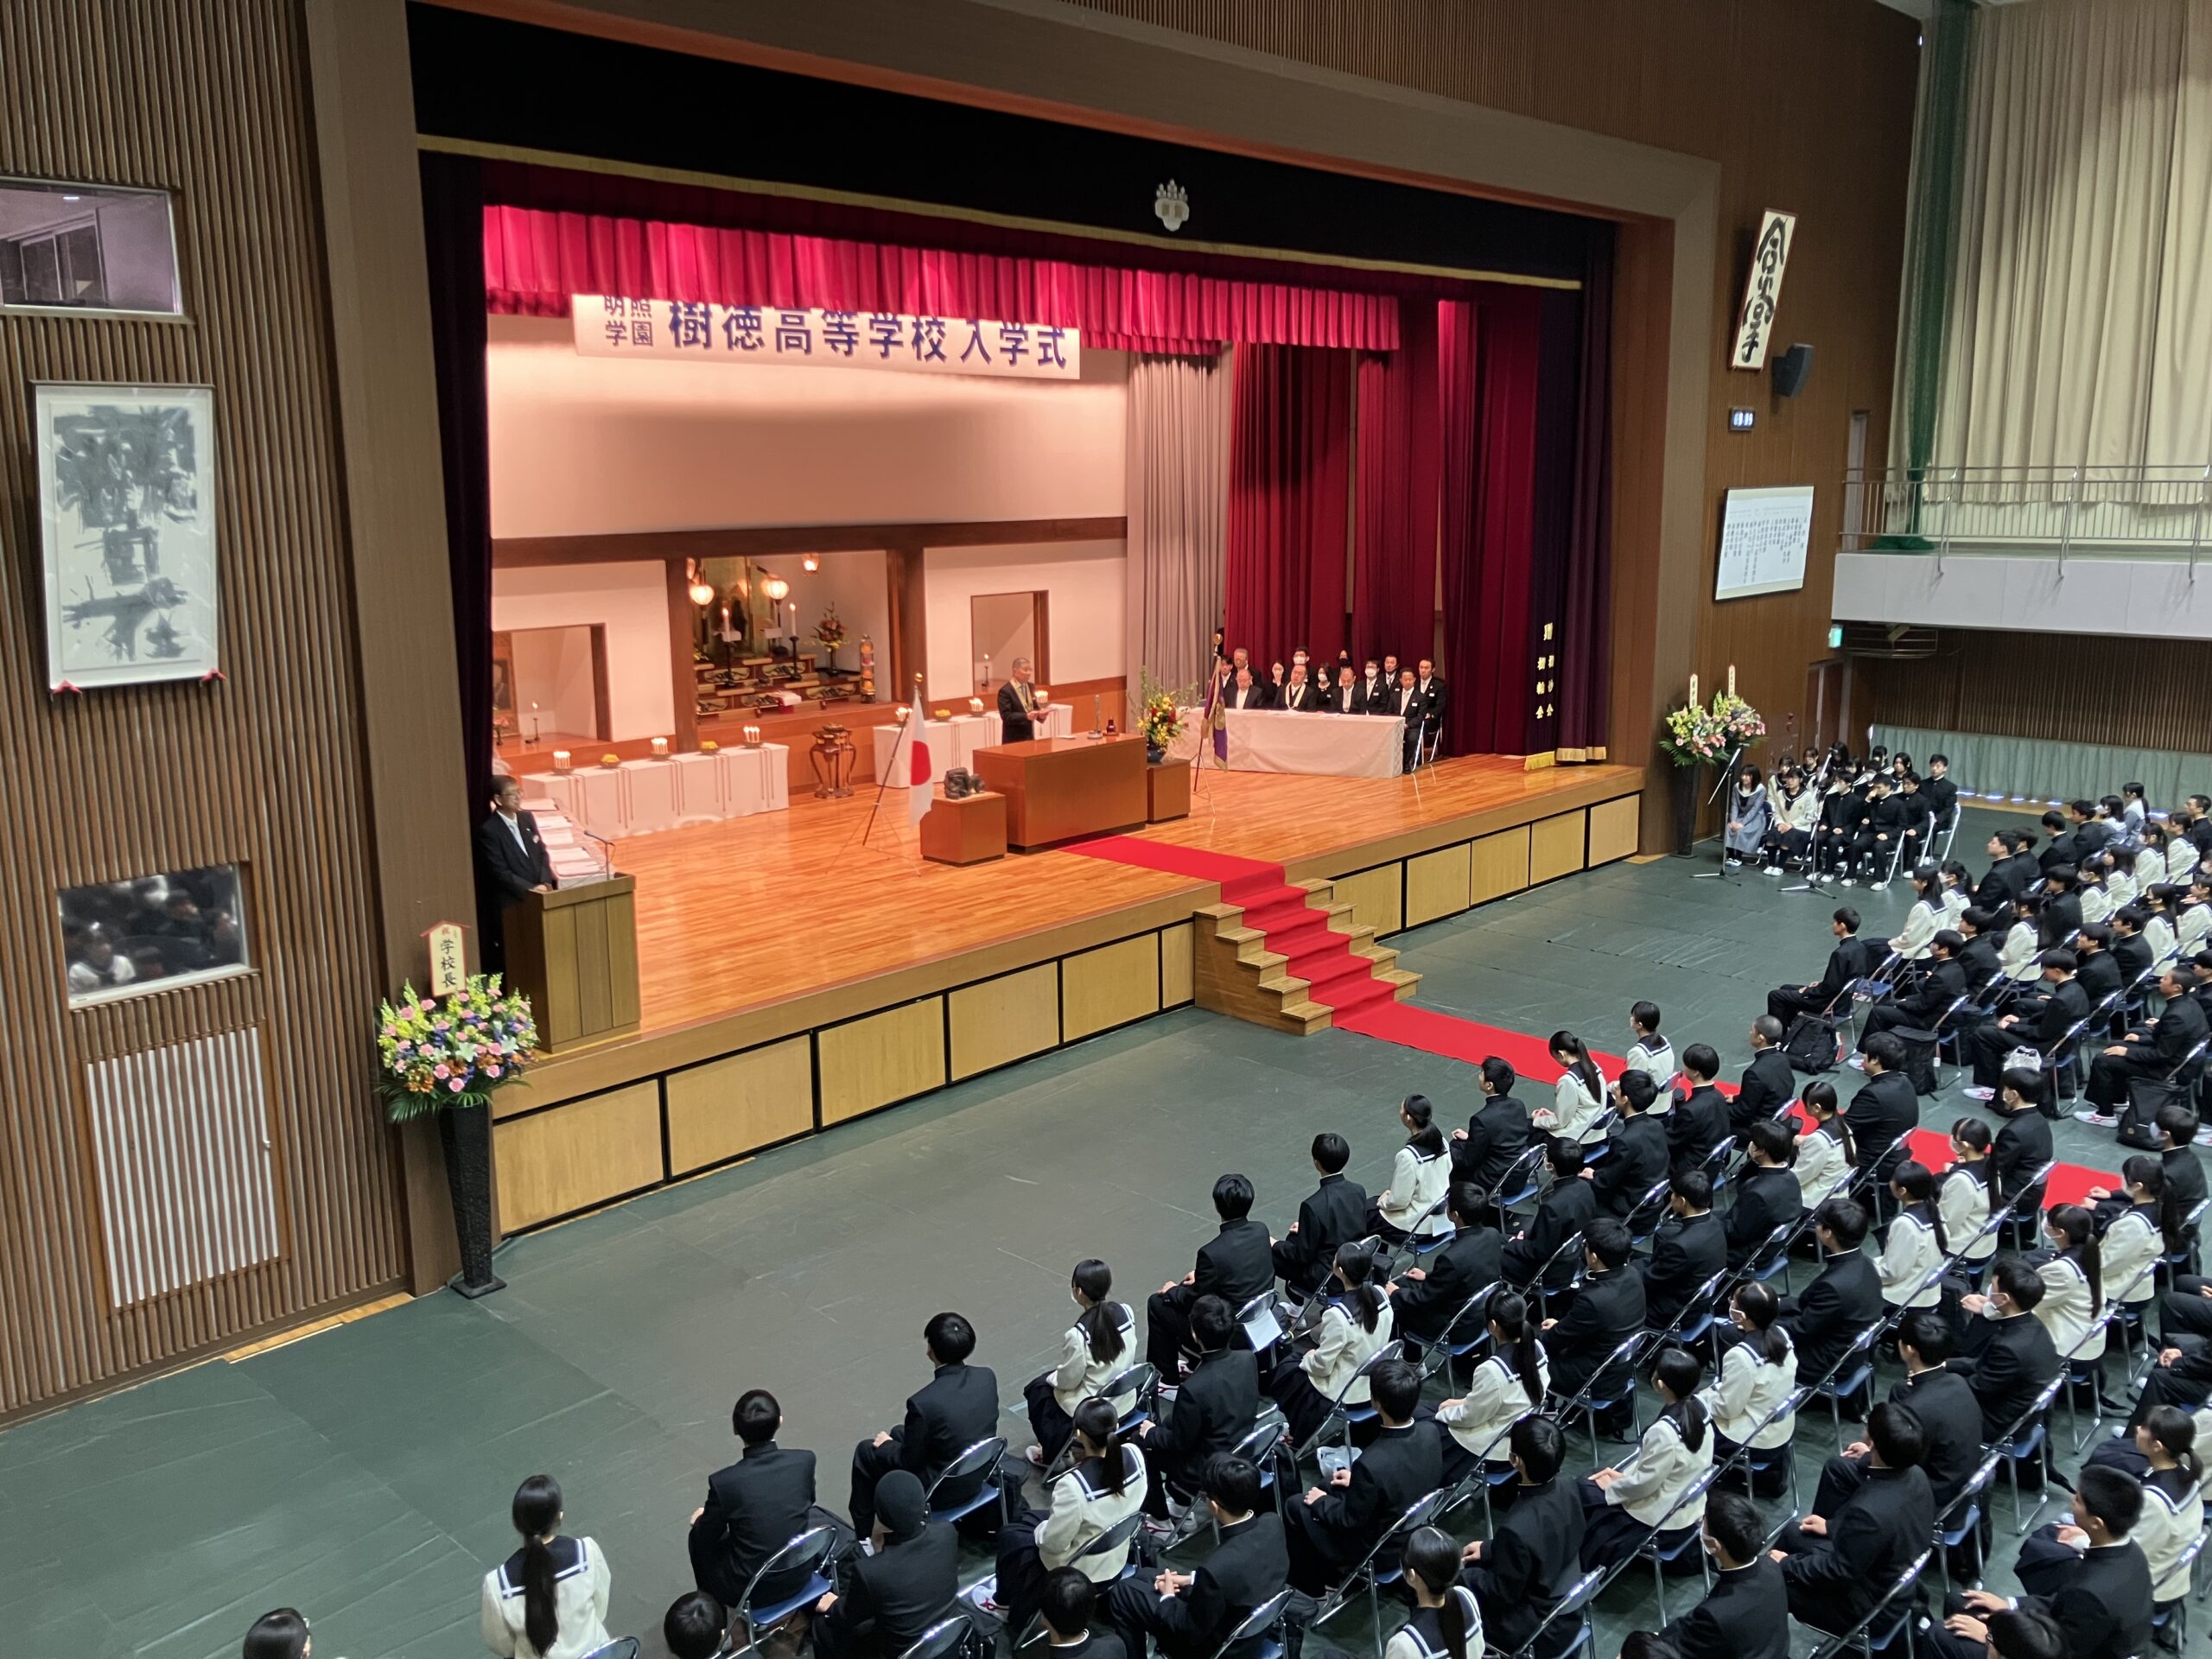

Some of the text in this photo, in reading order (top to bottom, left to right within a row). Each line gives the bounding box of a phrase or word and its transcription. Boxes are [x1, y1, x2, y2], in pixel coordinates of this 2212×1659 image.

[605, 320, 654, 347] 学園
[668, 299, 1067, 370] 樹徳高等学校入学式
[440, 939, 456, 988] 学校長
